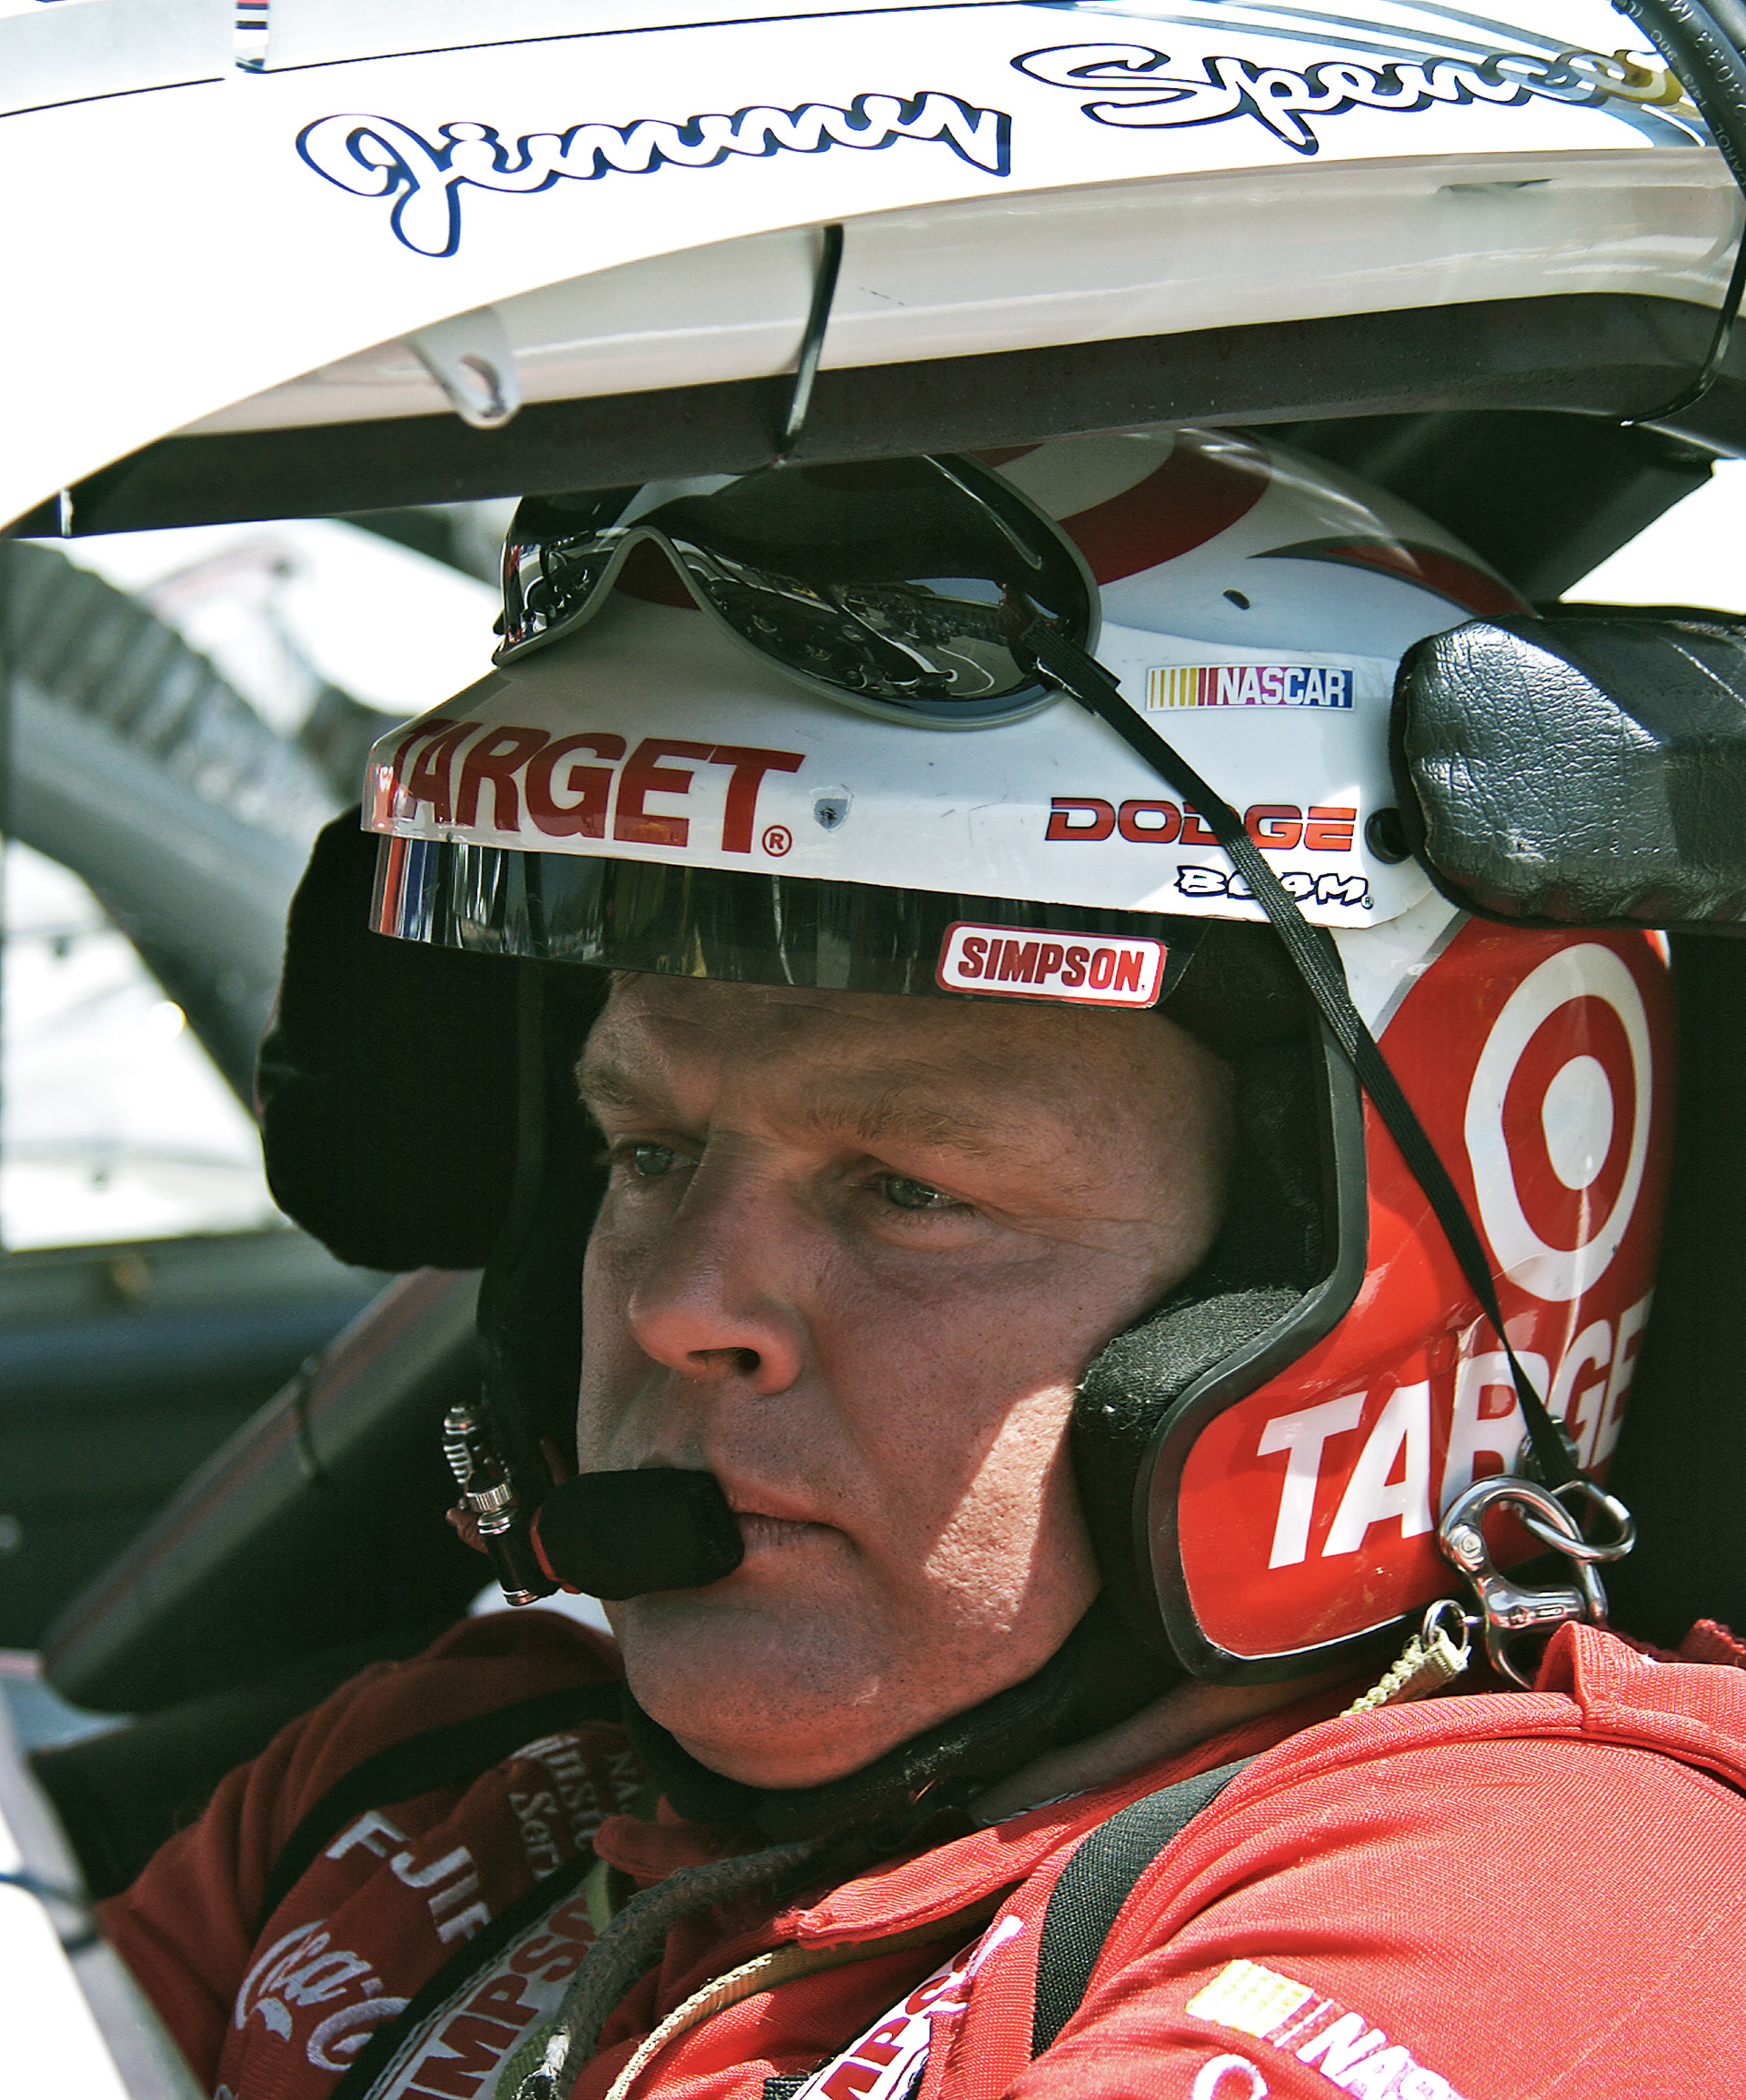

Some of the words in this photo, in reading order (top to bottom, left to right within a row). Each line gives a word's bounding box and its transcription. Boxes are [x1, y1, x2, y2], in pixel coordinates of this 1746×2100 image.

[296, 92, 1011, 257] Jimmy
[1214, 666, 1346, 708] NASCAR
[372, 718, 807, 855] TARGET
[1045, 797, 1357, 852] DODGE
[958, 936, 1146, 993] SIMPSON
[1257, 1290, 1653, 1570] TARGE
